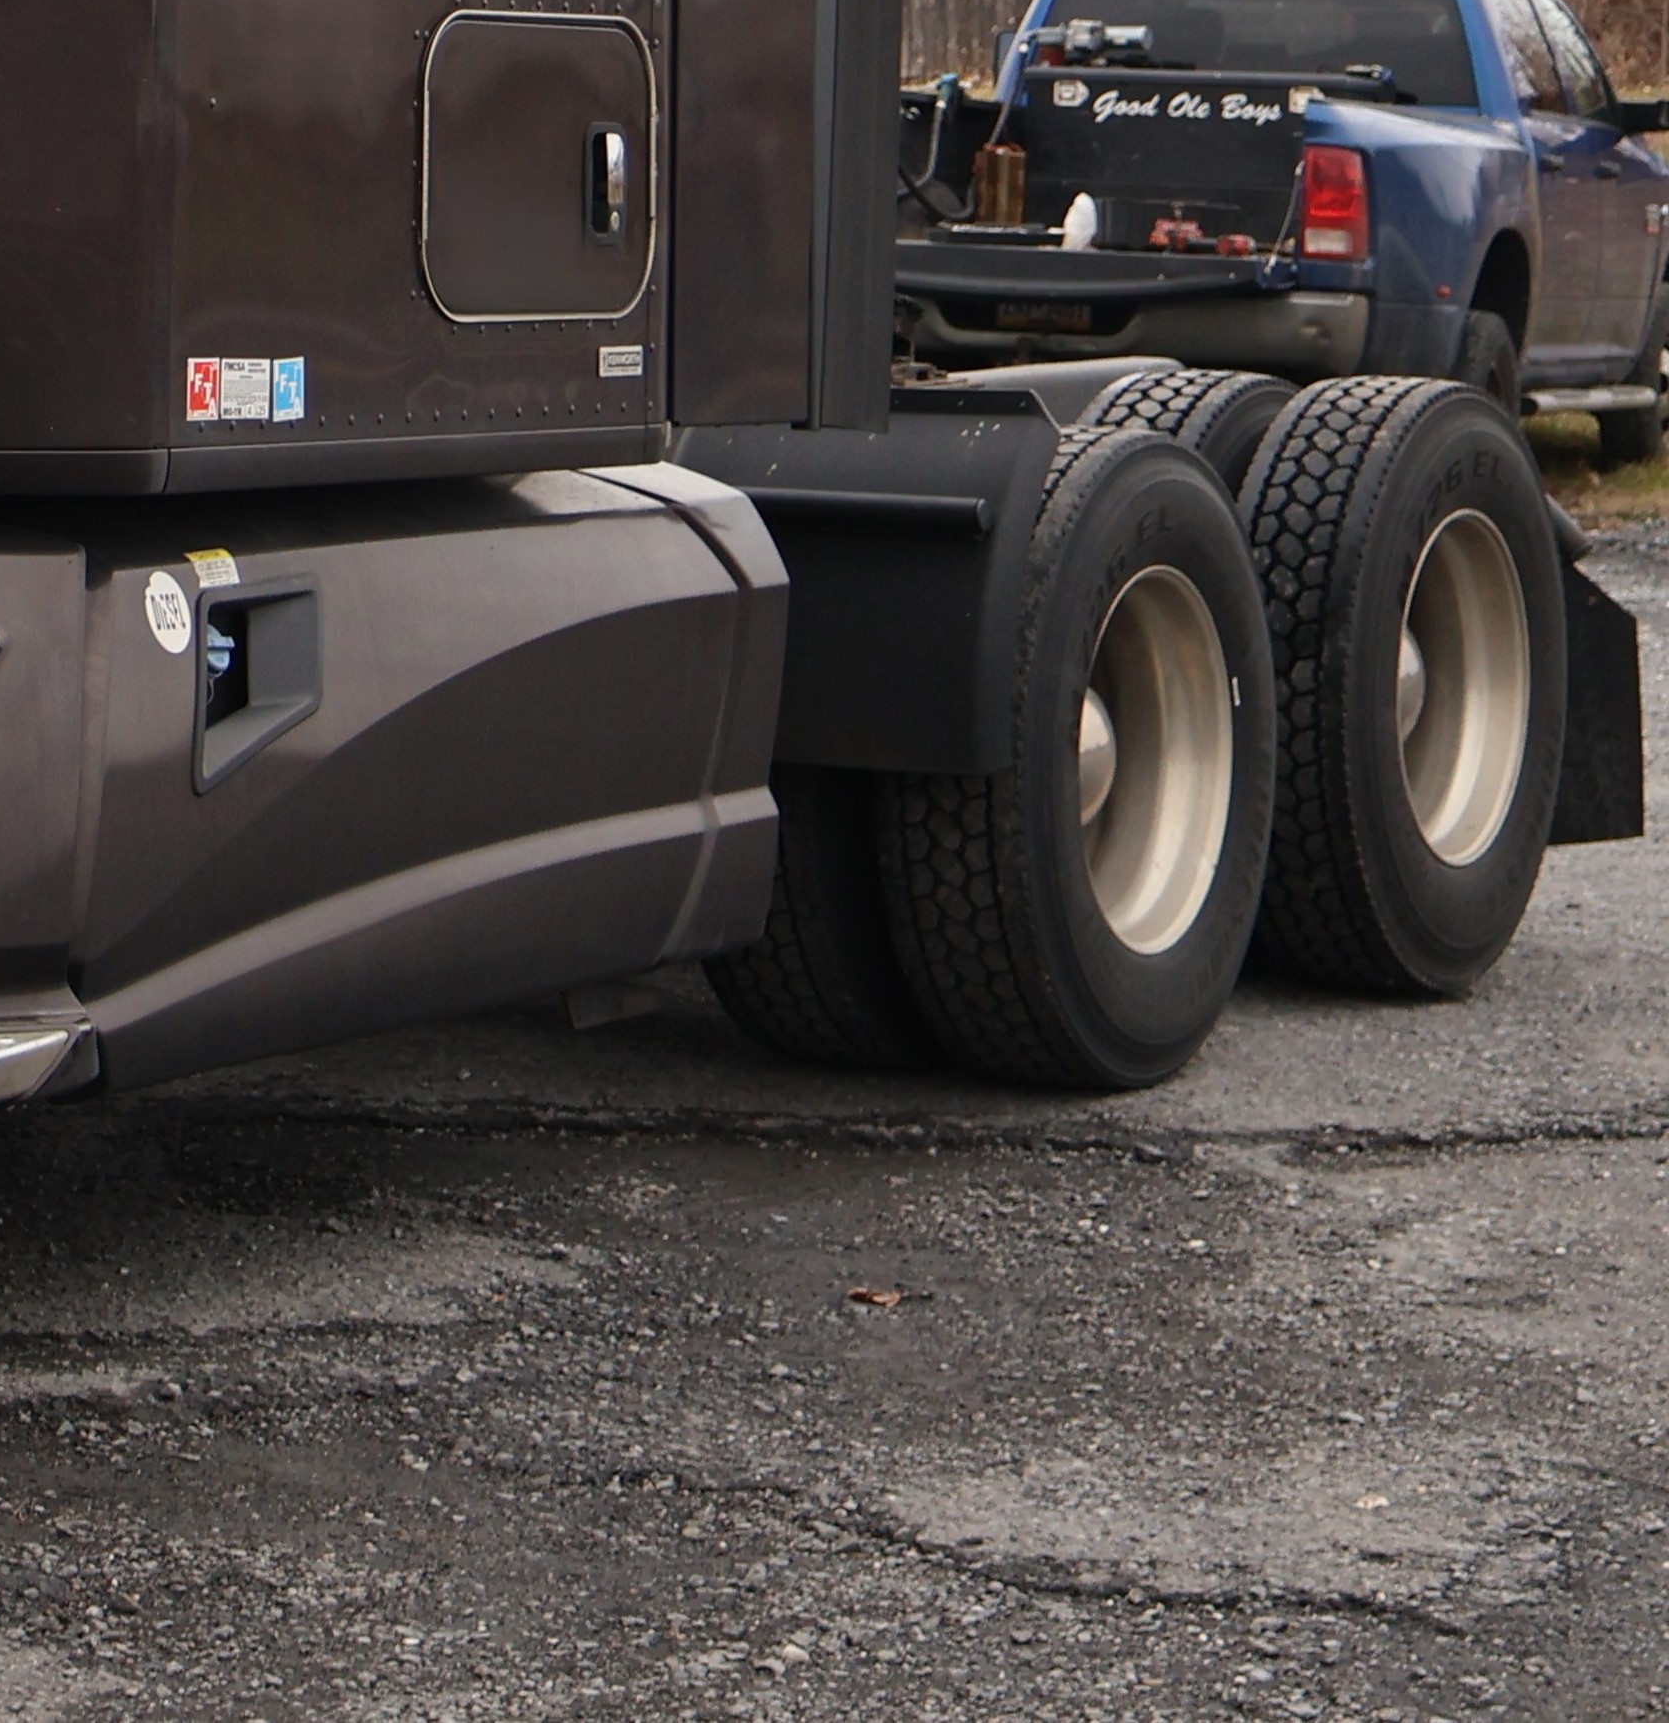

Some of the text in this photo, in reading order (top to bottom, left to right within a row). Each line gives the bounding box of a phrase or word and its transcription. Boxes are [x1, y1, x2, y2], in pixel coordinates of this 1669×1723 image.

[1092, 89, 1283, 126] Good Ole Boys
